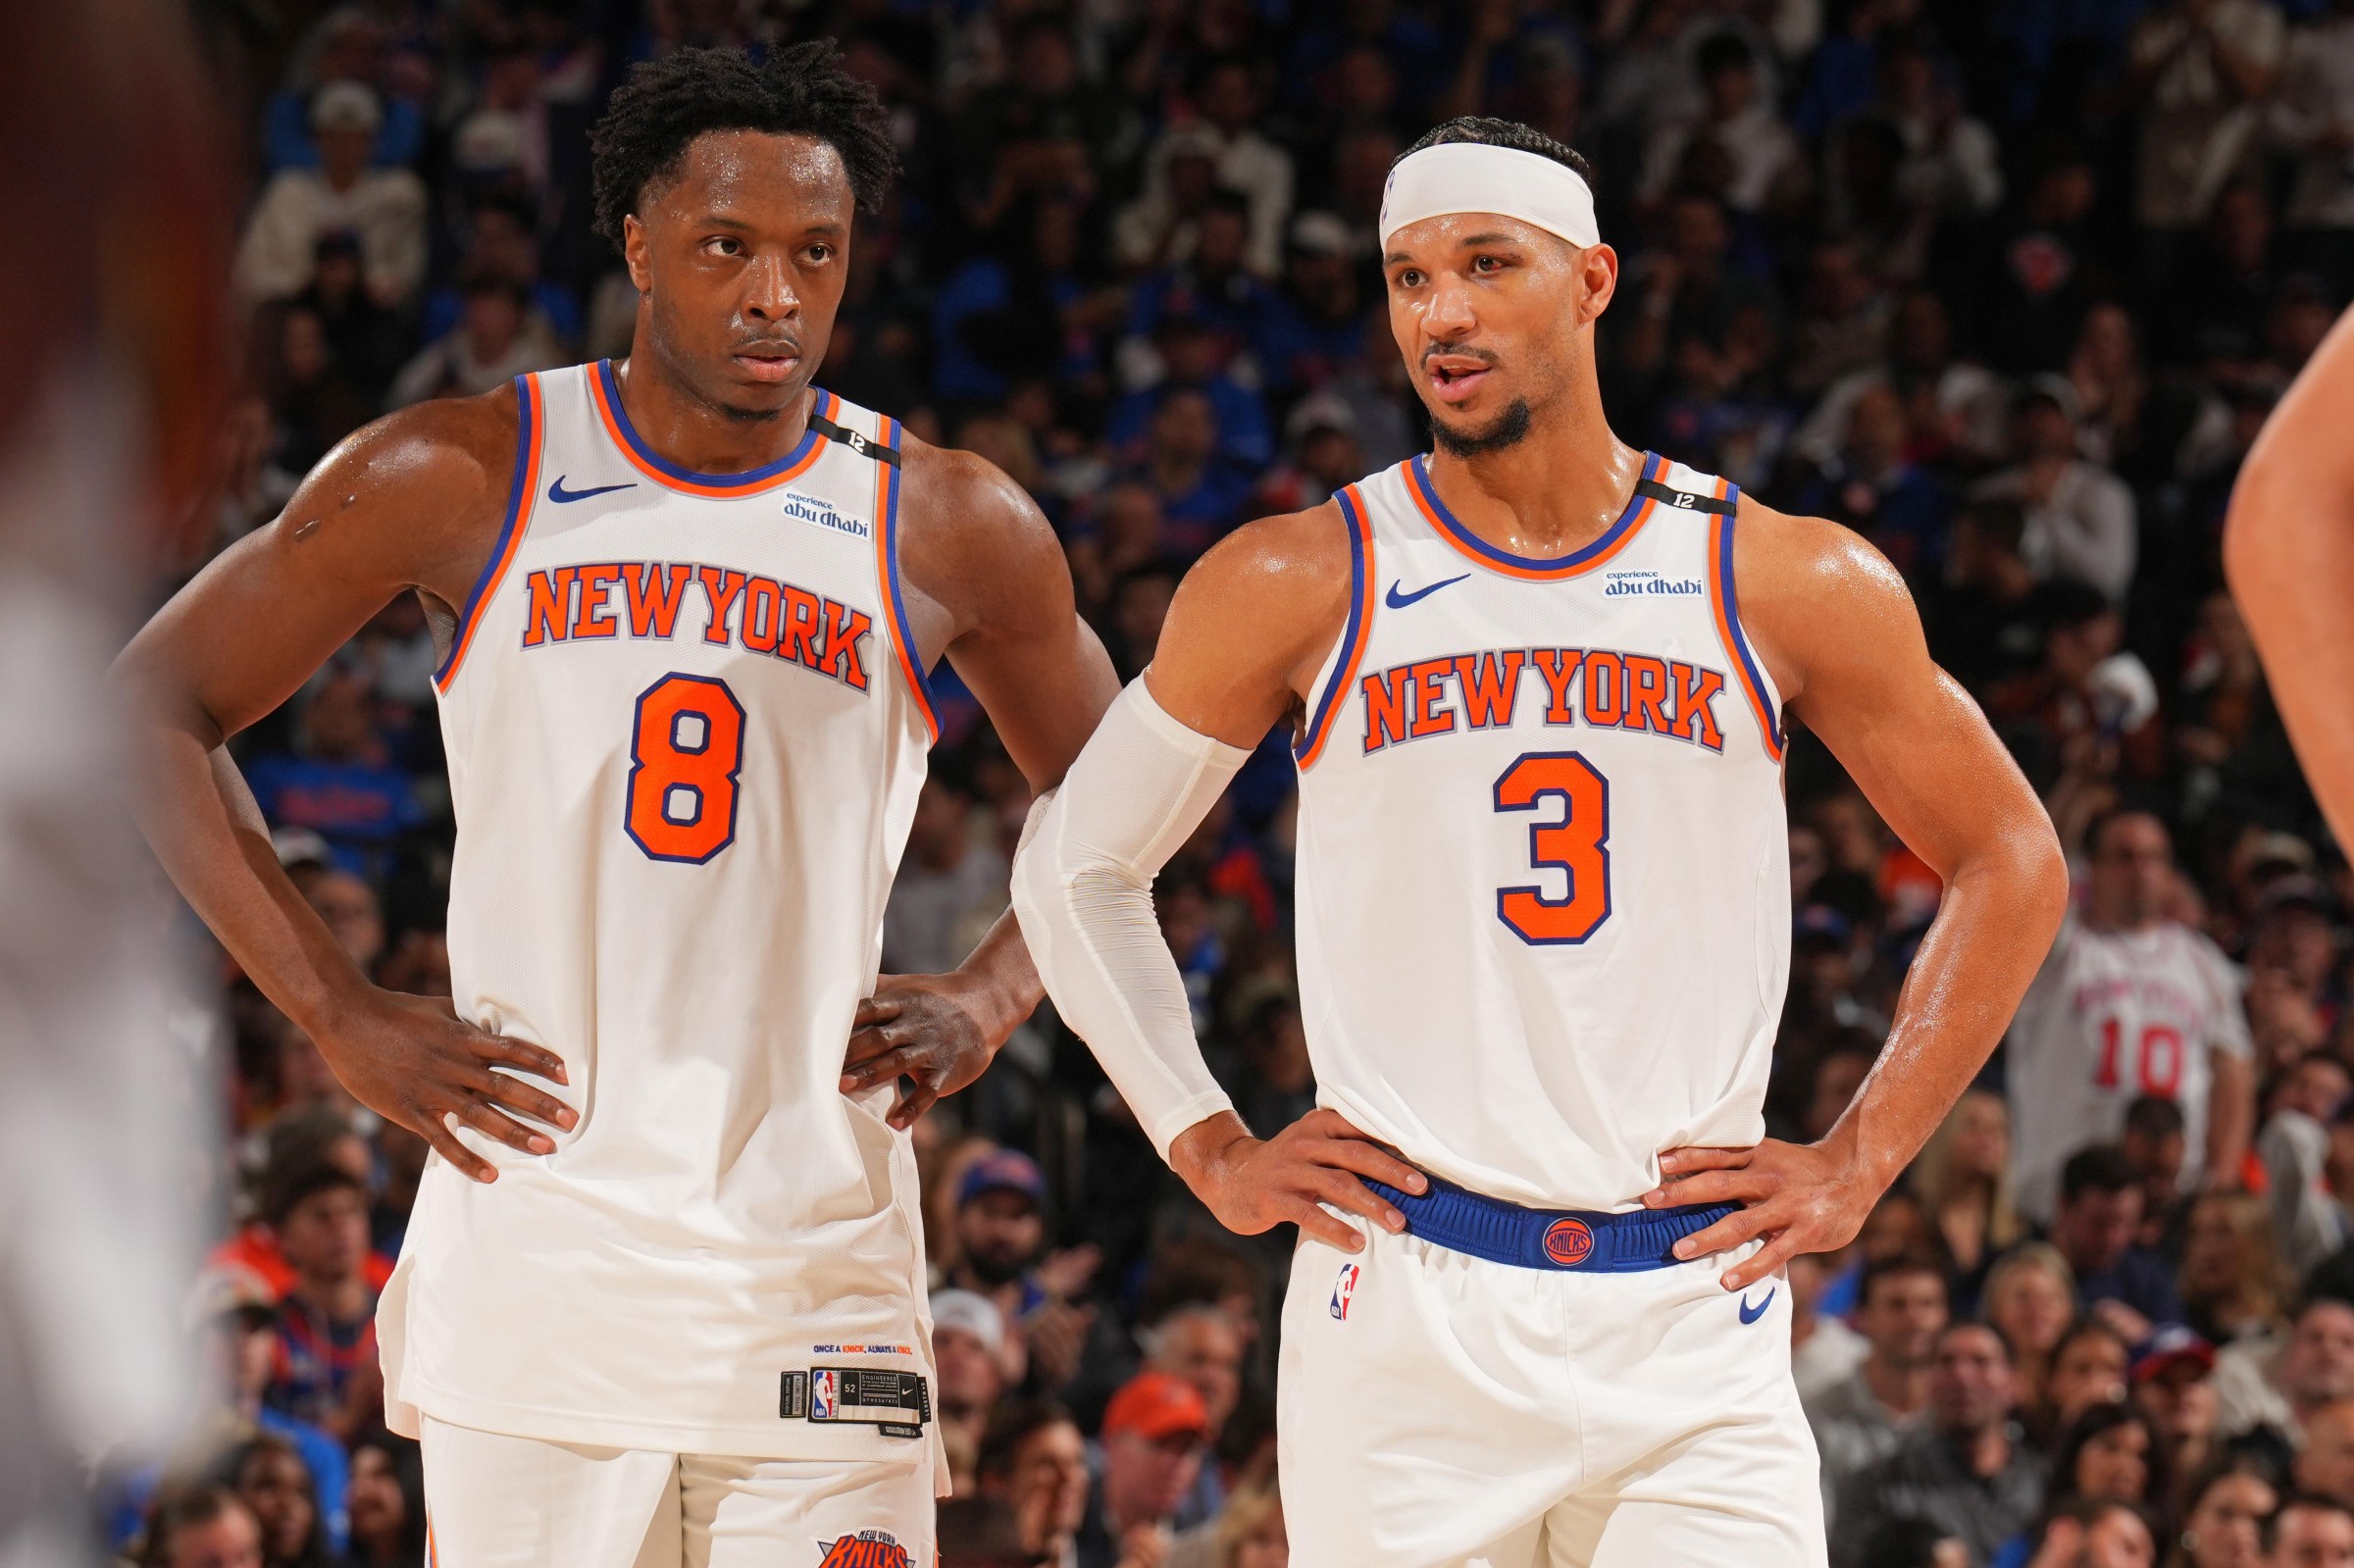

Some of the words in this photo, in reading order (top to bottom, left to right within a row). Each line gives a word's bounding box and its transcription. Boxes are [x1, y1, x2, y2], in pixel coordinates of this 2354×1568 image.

[848, 431, 865, 453] 12
[787, 491, 833, 510] experience
[1673, 492, 1695, 509] 12
[784, 502, 817, 522] abu
[820, 511, 868, 537] dhabi
[1607, 571, 1659, 580] experience
[1605, 581, 1643, 595] abu
[1647, 579, 1702, 595] dhabi
[521, 561, 692, 651] NEW
[697, 563, 875, 697] YORK
[1360, 647, 1526, 757] NEW
[1530, 646, 1726, 755] YORK
[624, 671, 746, 865] 8
[1493, 751, 1612, 945] 3
[2094, 1014, 2184, 1099] 10
[1550, 1232, 1587, 1253] KNICKS
[813, 1344, 835, 1353] ONCE
[844, 1384, 856, 1393] 52
[858, 1530, 877, 1540] NEW
[878, 1531, 896, 1546] YORK
[818, 1534, 908, 1568] KNICKS
